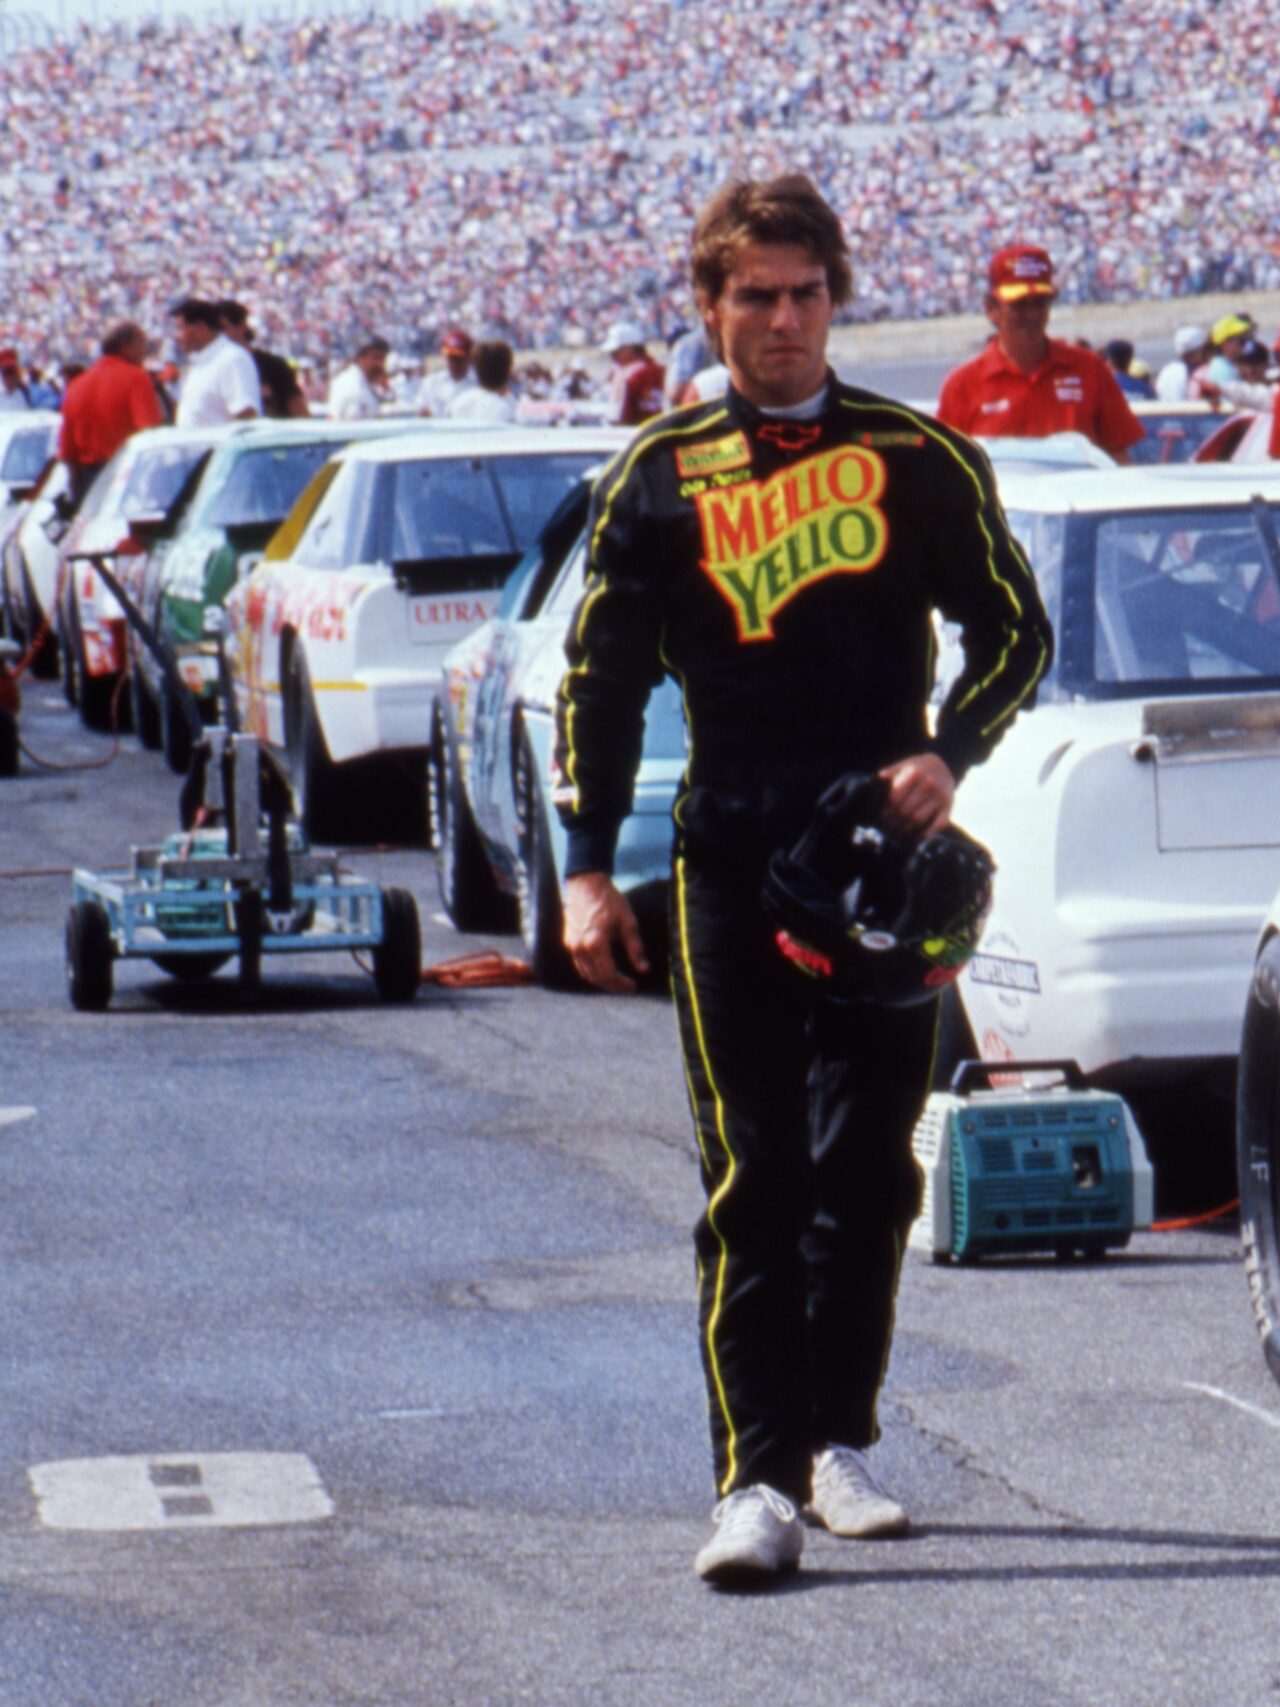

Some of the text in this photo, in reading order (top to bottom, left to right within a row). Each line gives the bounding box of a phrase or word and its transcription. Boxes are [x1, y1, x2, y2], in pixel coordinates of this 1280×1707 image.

[710, 452, 875, 564] MELLO
[415, 600, 488, 625] ULTRA
[722, 508, 876, 631] YELLO
